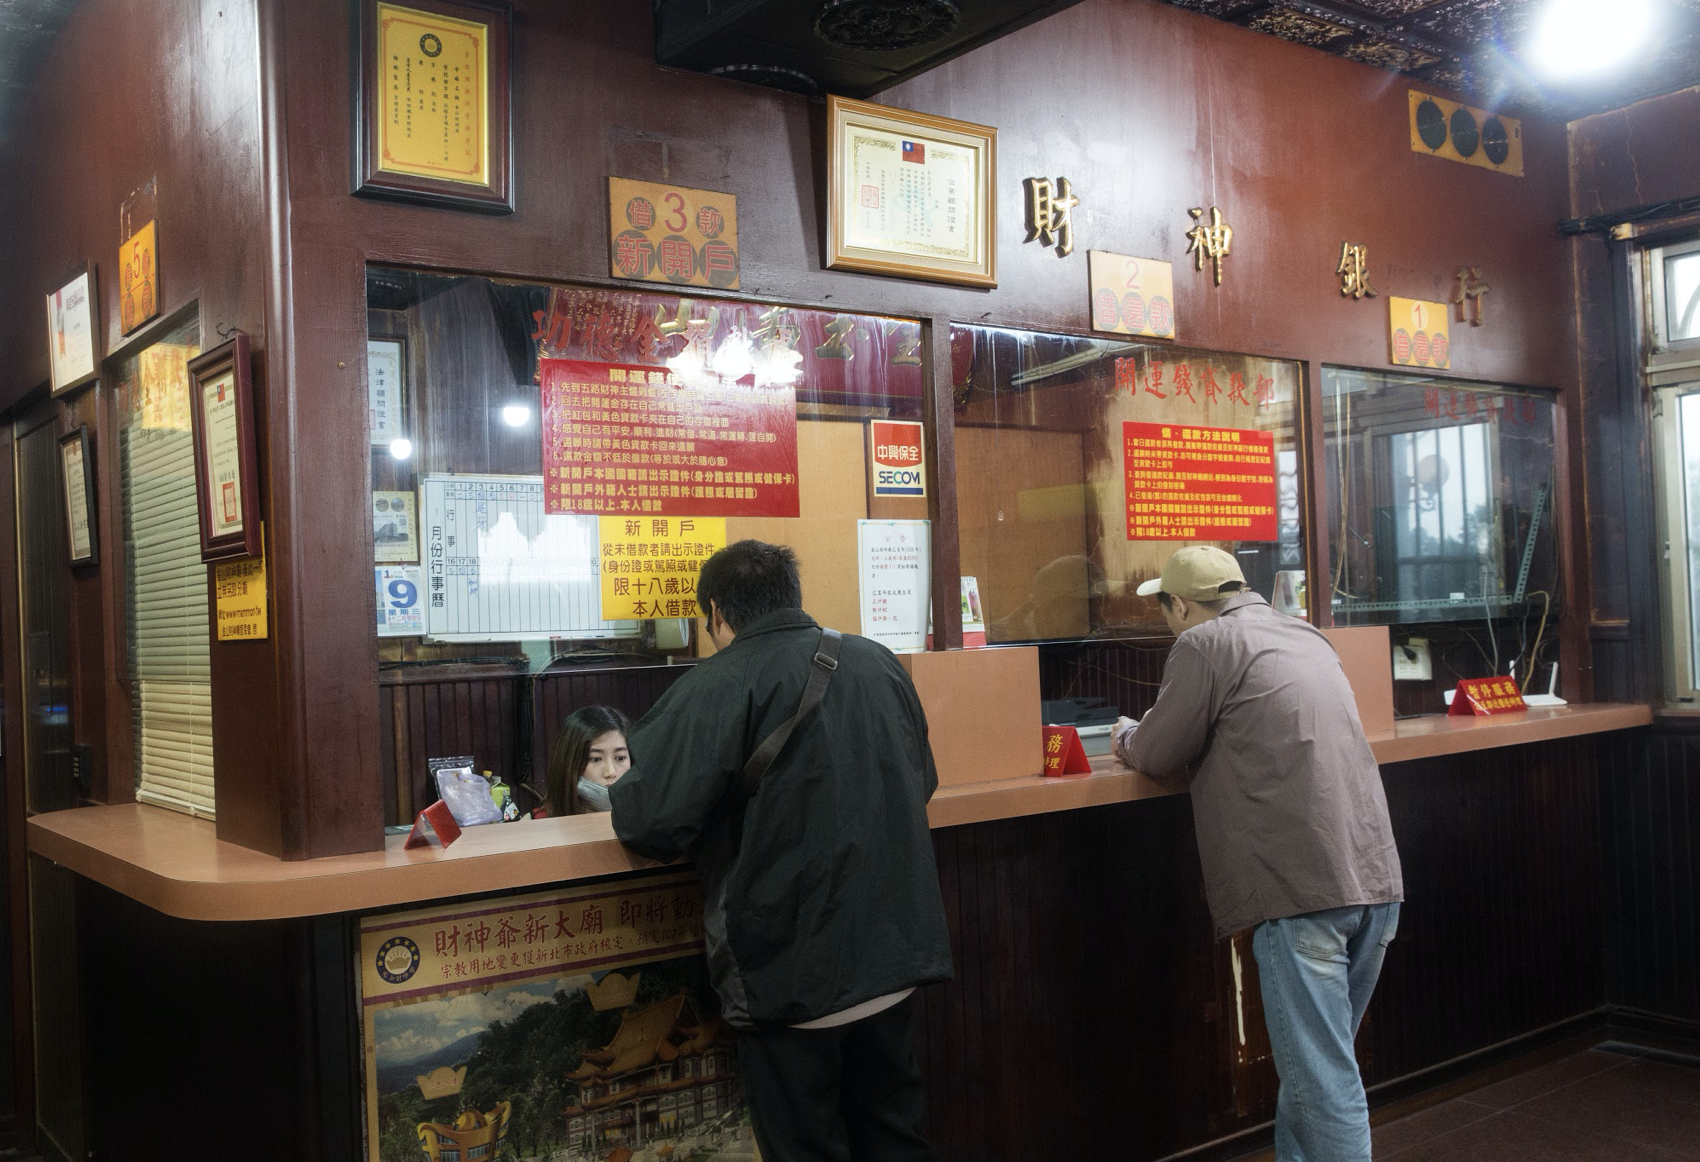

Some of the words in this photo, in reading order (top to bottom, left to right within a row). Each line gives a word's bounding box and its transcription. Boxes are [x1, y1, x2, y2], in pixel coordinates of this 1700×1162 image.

[629, 200, 652, 228] 借
[664, 192, 687, 232] 3
[699, 209, 721, 235] 款
[133, 240, 140, 279] 5
[617, 235, 734, 280] 新開戶
[1125, 260, 1140, 289] 2
[1094, 291, 1173, 331] 借還款
[1414, 304, 1422, 328] 1
[1115, 356, 1274, 411] 開運錢貸款部
[877, 444, 919, 460] 中興保全
[879, 470, 920, 485] SECOM
[625, 519, 694, 537] 新開戶
[602, 543, 714, 556] 從未借款者請出示證件
[430, 526, 444, 608] 月份行事曆
[388, 580, 418, 609] 9
[614, 578, 696, 596] 限十八歲以
[388, 608, 421, 616] 星期三
[633, 599, 697, 617] 本人借款
[1046, 734, 1063, 753] 務
[433, 904, 604, 959] 財神爺新大廟
